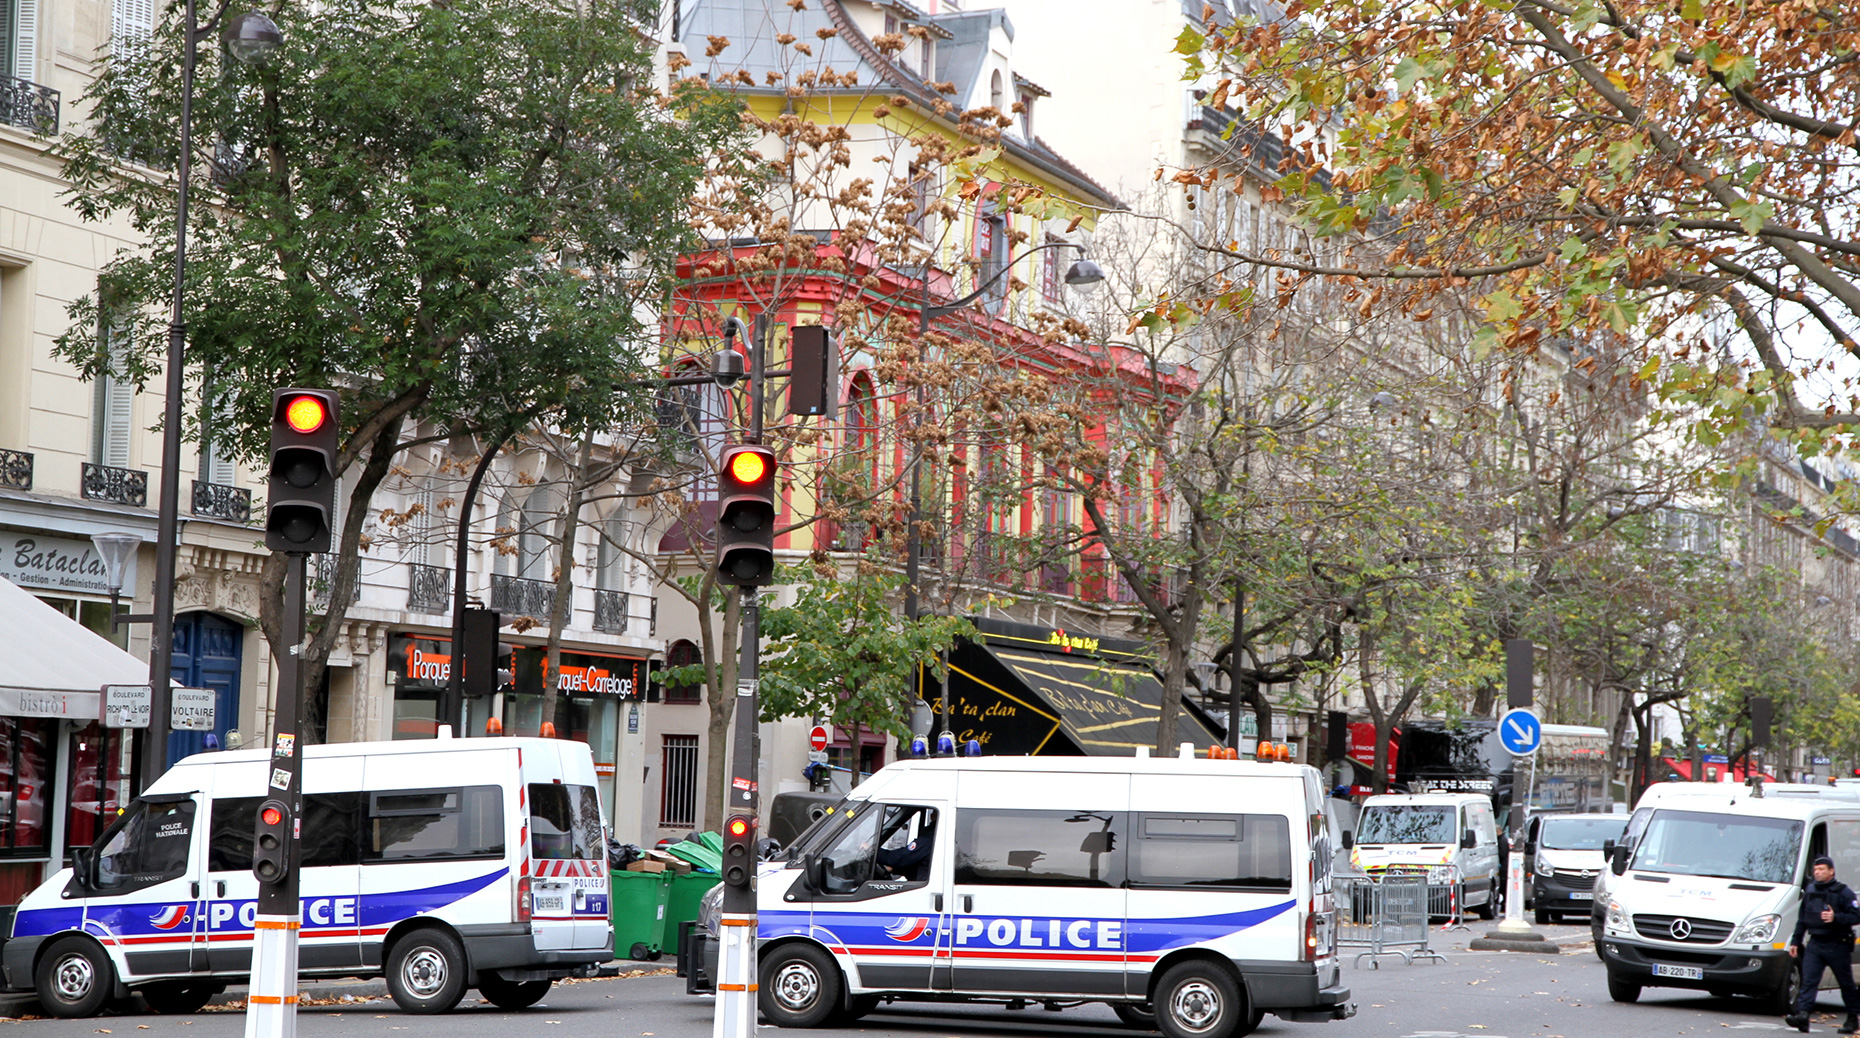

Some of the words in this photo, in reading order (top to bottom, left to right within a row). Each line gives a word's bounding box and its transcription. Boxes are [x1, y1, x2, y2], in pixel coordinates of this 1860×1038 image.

[20, 572, 49, 584] Gestion
[59, 576, 107, 590] Administratio
[413, 649, 452, 686] Parque
[113, 691, 145, 699] BOULEVARD
[178, 694, 210, 702] BOULEVARD
[20, 692, 58, 714] bistrò
[173, 706, 214, 717] VOLTAIRE
[1440, 779, 1457, 790] THE
[1458, 780, 1493, 790] STREET
[161, 822, 182, 831] POLICE
[155, 828, 188, 838] NATIONALE
[575, 878, 598, 888] POLICE
[868, 883, 904, 891] TRANSIT
[955, 917, 1122, 949] POLICE
